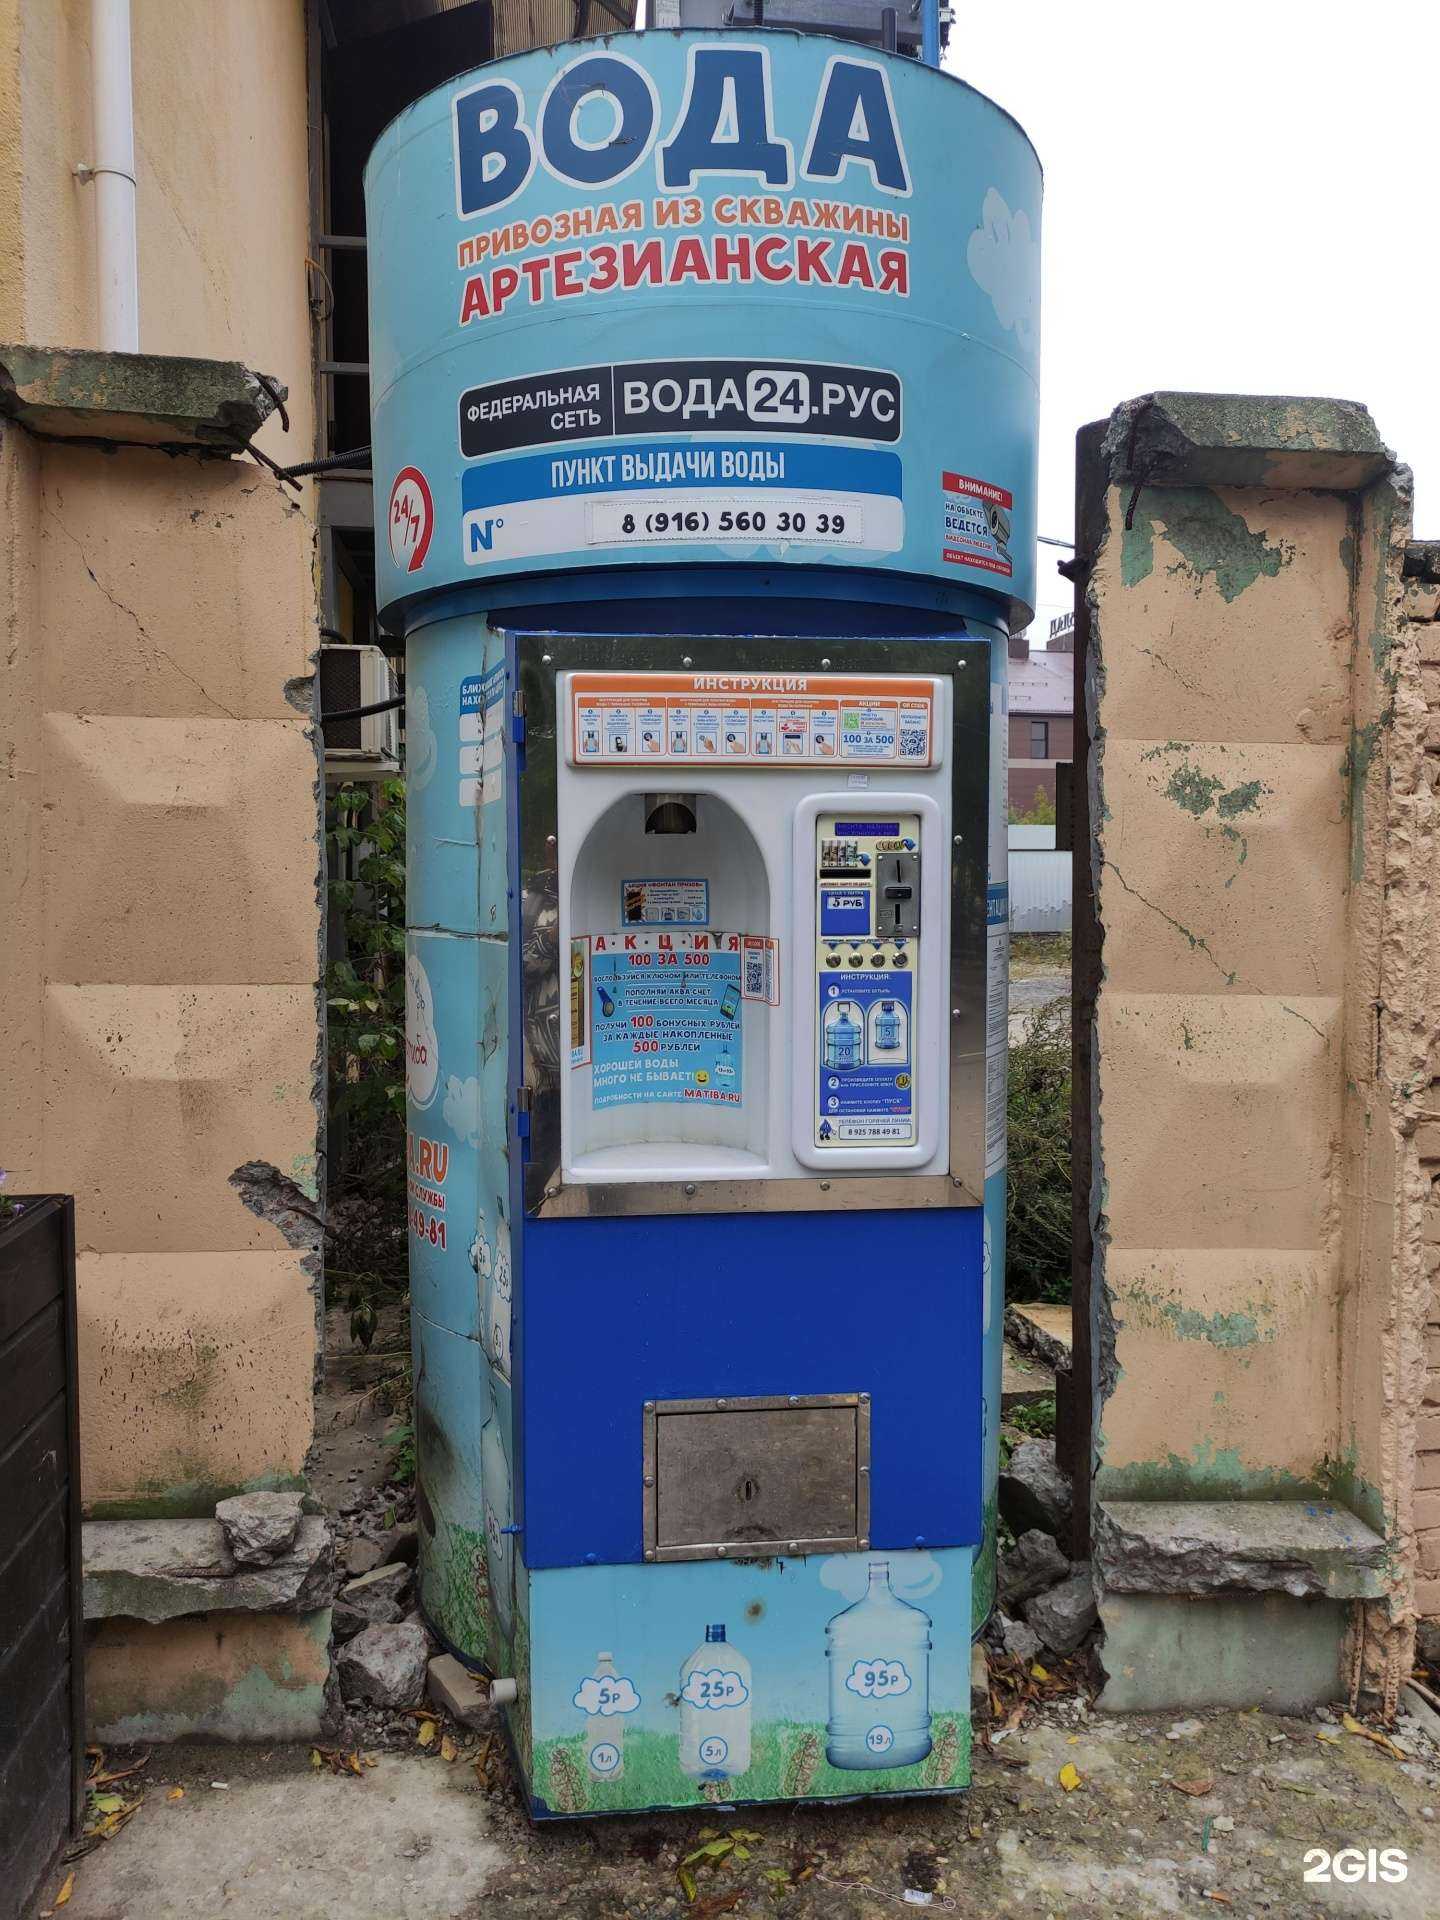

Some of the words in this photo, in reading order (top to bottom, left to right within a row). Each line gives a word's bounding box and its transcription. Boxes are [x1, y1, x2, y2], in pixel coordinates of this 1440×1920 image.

[455, 46, 911, 217] ВОДА
[457, 200, 642, 267] ПРИВОЗНАЯ
[656, 197, 702, 226] ИЗ
[713, 197, 909, 241] СКВАЖИНЫ
[459, 237, 909, 325] АРТЕЗИАНСКАЯ
[466, 384, 601, 424] ФЕДЕРАЛЬНАЯ
[623, 376, 896, 424] ВОДА24.РУС
[550, 410, 602, 431] СЕТЬ
[550, 455, 615, 488] ПУНКТ
[620, 451, 715, 483] ВЫДАЧИ
[722, 450, 786, 480] ВОДЫ
[958, 478, 1003, 502] ВНИМАНИЕ!
[945, 502, 955, 512] НА
[956, 504, 984, 520] ОБЪЕКТЕ
[393, 494, 420, 547] 24/7
[621, 512, 636, 534] 8
[644, 511, 710, 534] (916)
[718, 511, 767, 533] 560
[775, 512, 806, 534] 30
[815, 513, 845, 535] 39
[945, 517, 988, 537] ВЕДЕТСЯ
[692, 677, 808, 692] ИНСТРУКЦИЯ
[843, 734, 862, 744] 100
[863, 736, 874, 744] ЗА
[875, 735, 894, 745] 500
[833, 897, 840, 908] 5
[628, 954, 651, 966] 100
[657, 953, 678, 966] ЗА
[684, 953, 710, 966] 500
[645, 972, 681, 981] КЛЮЧОМ
[625, 998, 658, 1006] ТЕЧЕНИЕ
[659, 997, 685, 1005] ВСЕГО
[686, 997, 719, 1007] МЕСЯЦА
[595, 1020, 627, 1032] ПОЛУЧИ
[630, 1015, 654, 1028] 100
[656, 1019, 706, 1028] БОНУСНЫХ
[885, 1027, 891, 1037] 5
[603, 1033, 615, 1042] ЗА
[615, 1030, 660, 1041] КАЖДЫЕ
[662, 1030, 733, 1042] НАКОПЛЕННЫЕ
[633, 1040, 659, 1053] 500
[660, 1042, 701, 1052] РУБЛЕЙ
[838, 1047, 851, 1056] 20
[593, 1058, 642, 1074] ХОРОШЕЙ
[644, 1058, 679, 1069] ВОДЫ
[593, 1075, 627, 1088] МНОГО
[629, 1072, 643, 1083] НЕ
[646, 1071, 695, 1083] БЫВАЕТ!
[594, 1091, 642, 1105] ПОДРОБНОСТИ
